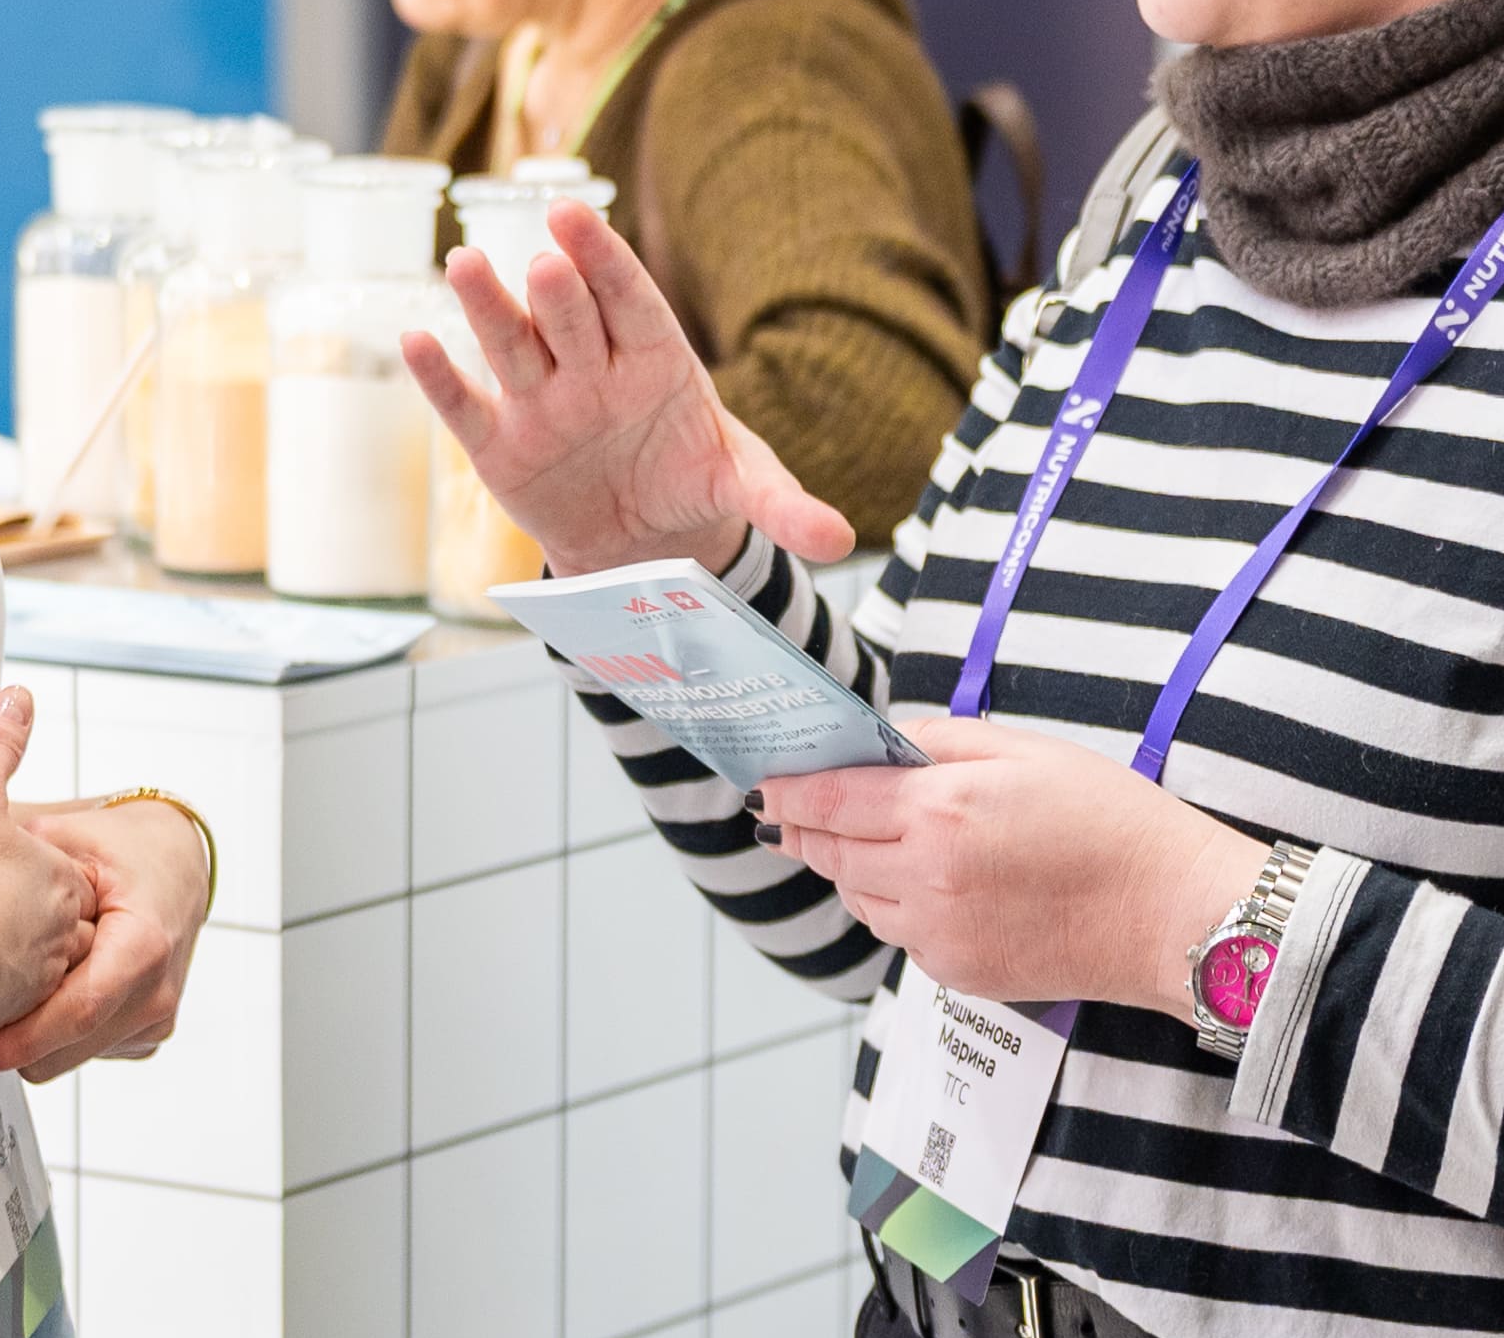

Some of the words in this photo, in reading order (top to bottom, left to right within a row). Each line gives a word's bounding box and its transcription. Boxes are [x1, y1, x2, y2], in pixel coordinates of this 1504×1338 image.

[617, 677, 767, 703] РЕВОЛЮЦИЯ
[765, 672, 788, 687] В
[933, 983, 1022, 1056] Рышманова
[938, 1023, 997, 1078] Марина
[944, 1070, 971, 1106] ТГС
